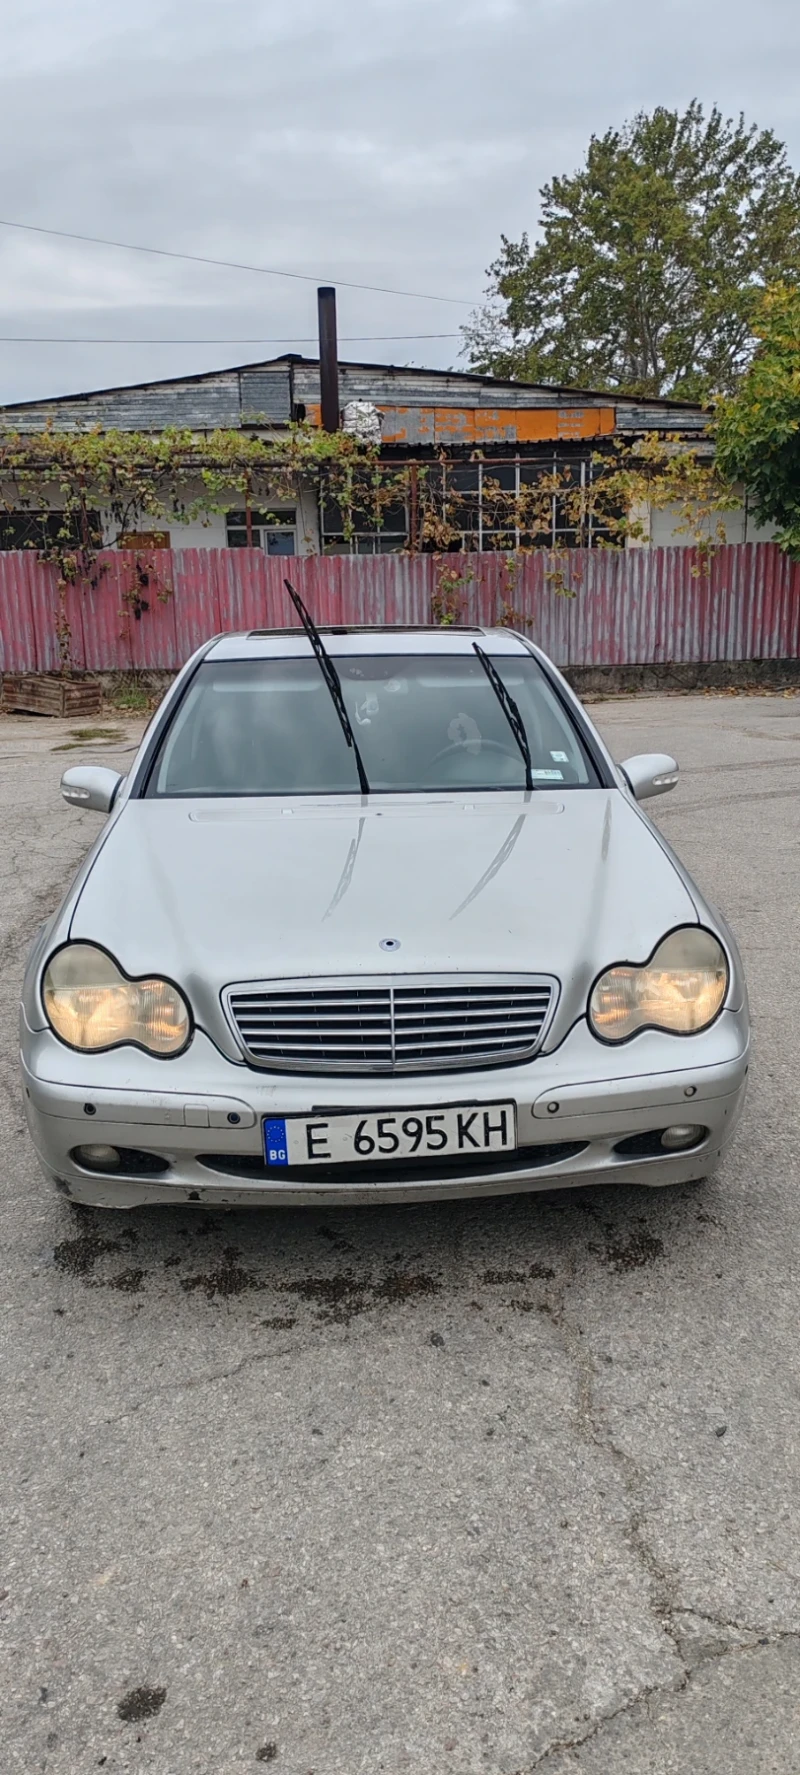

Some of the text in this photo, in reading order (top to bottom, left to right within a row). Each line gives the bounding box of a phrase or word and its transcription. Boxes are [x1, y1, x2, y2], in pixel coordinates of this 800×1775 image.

[306, 1110, 507, 1159] E 6595 KH
[269, 1149, 286, 1160] BG
